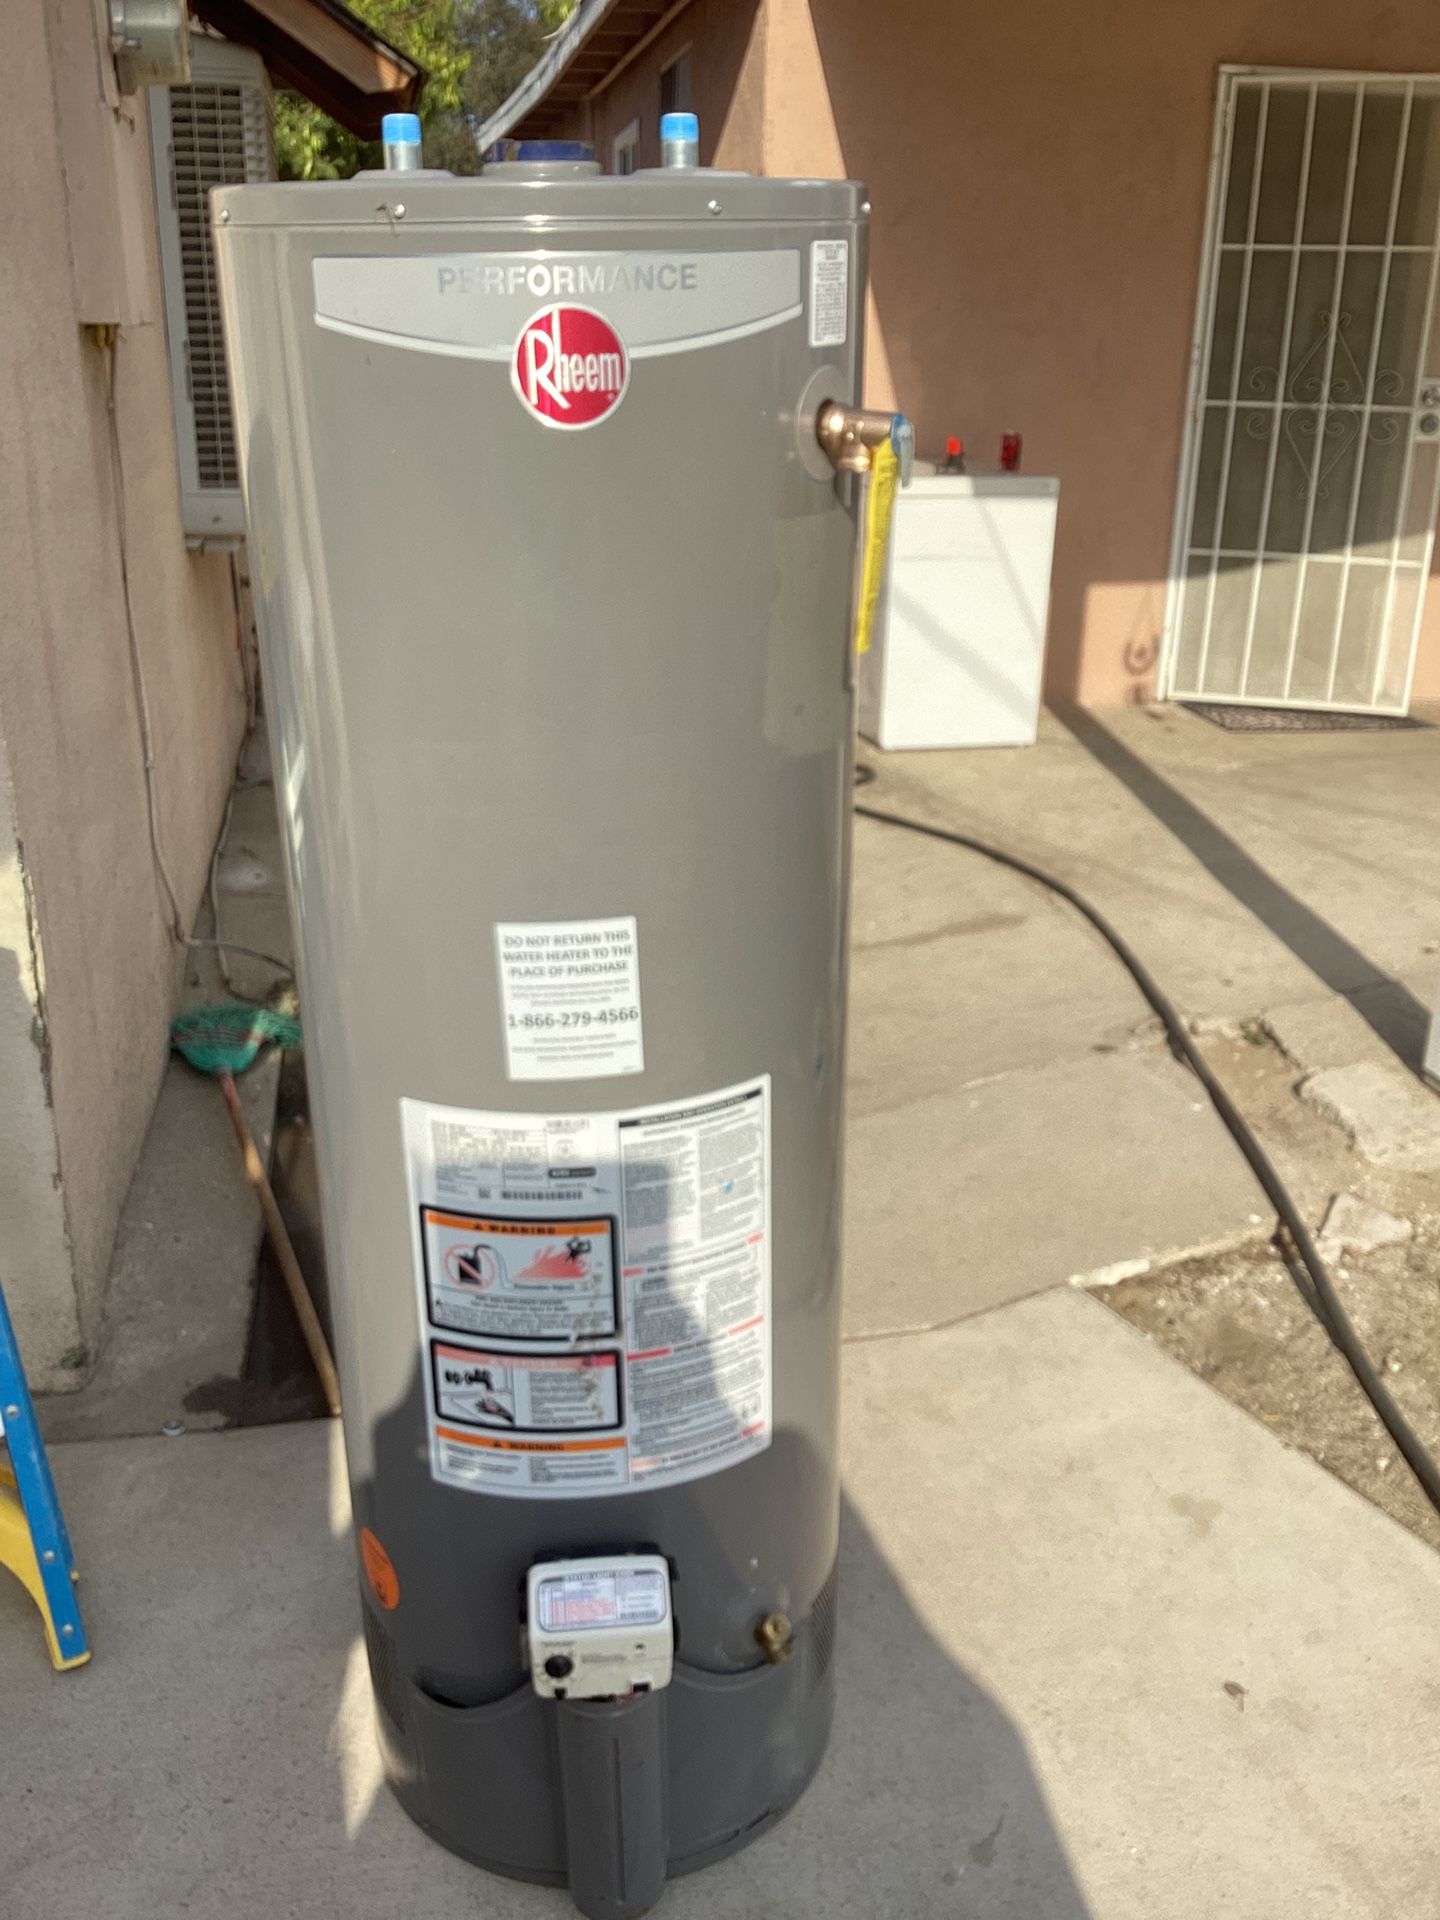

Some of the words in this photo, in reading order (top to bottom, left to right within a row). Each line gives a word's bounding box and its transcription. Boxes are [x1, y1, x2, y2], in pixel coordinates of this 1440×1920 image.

[437, 263, 699, 297] PERFORMANCE
[525, 308, 622, 410] Rheem
[504, 935, 523, 948] DO
[526, 934, 550, 947] NOT
[554, 932, 602, 946] RETURN
[604, 929, 630, 942] THIS
[503, 950, 543, 962] WATER
[546, 948, 590, 961] HEATER
[593, 947, 609, 958] TO
[510, 966, 545, 977] PLACE
[548, 964, 565, 976] OF
[567, 961, 628, 975] PURCHASE
[508, 1007, 639, 1027] 1-866-279-4566
[509, 1441, 565, 1452] WARNING
